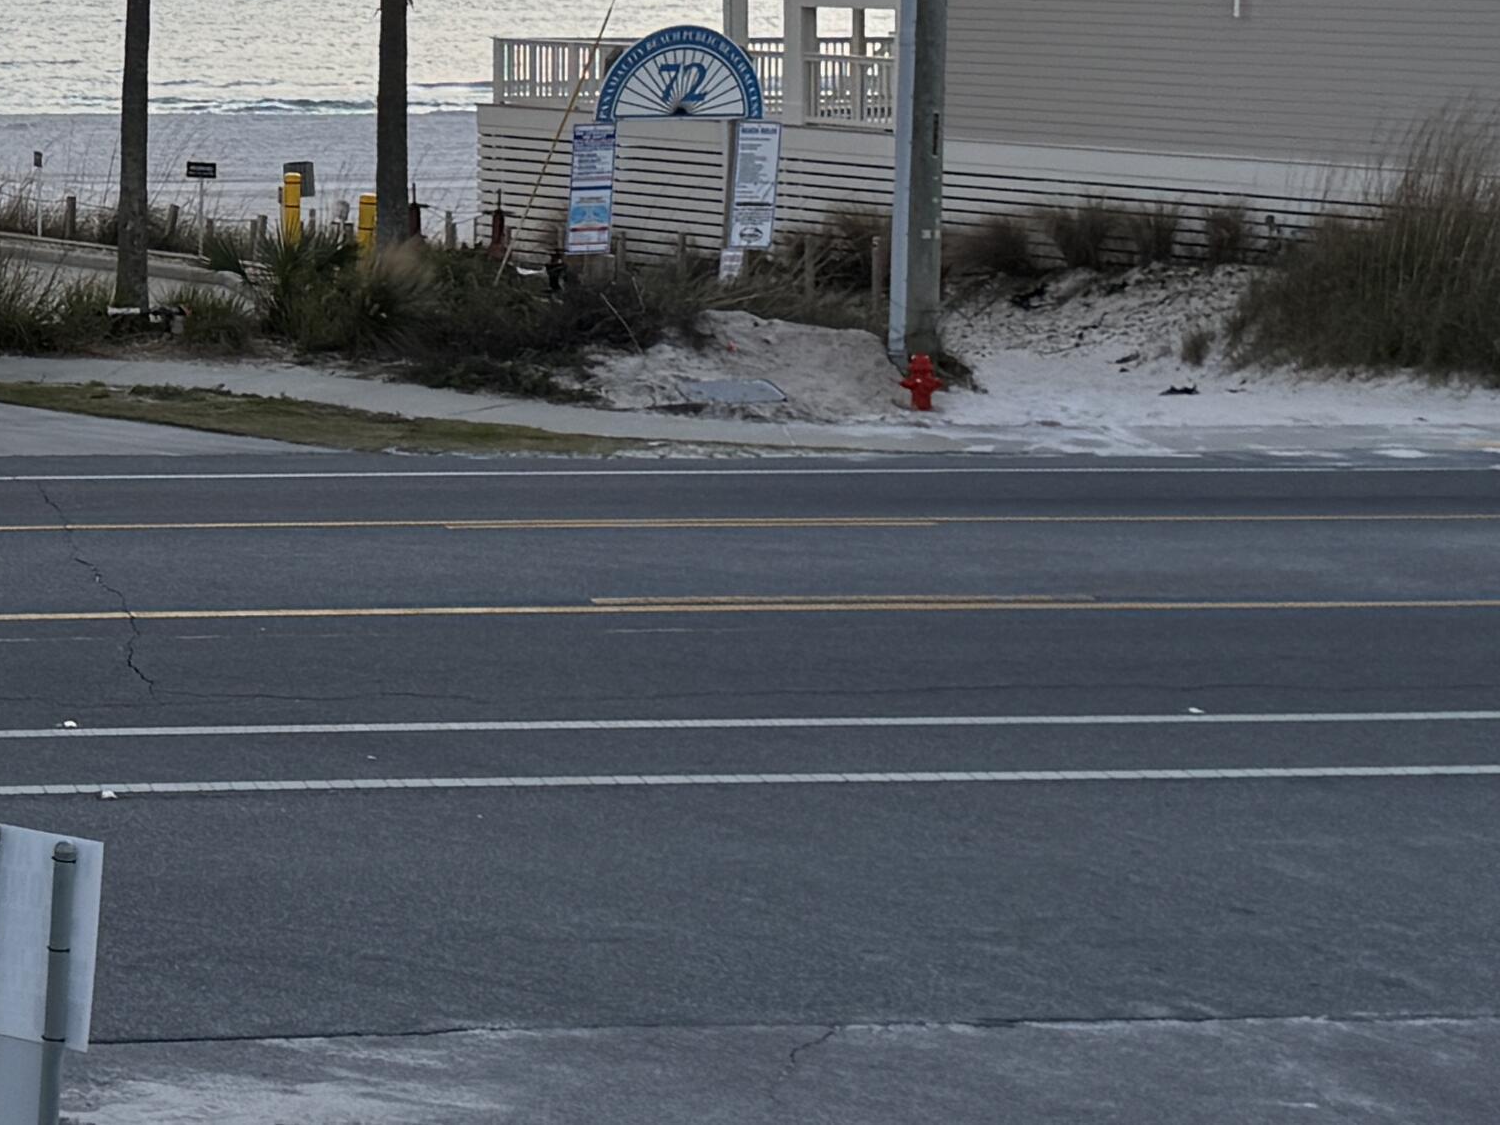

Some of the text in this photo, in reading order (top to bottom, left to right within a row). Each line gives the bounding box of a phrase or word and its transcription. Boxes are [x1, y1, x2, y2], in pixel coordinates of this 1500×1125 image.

[645, 31, 681, 51] BEACH
[682, 30, 718, 47] PUBLIC
[658, 62, 709, 104] 72
